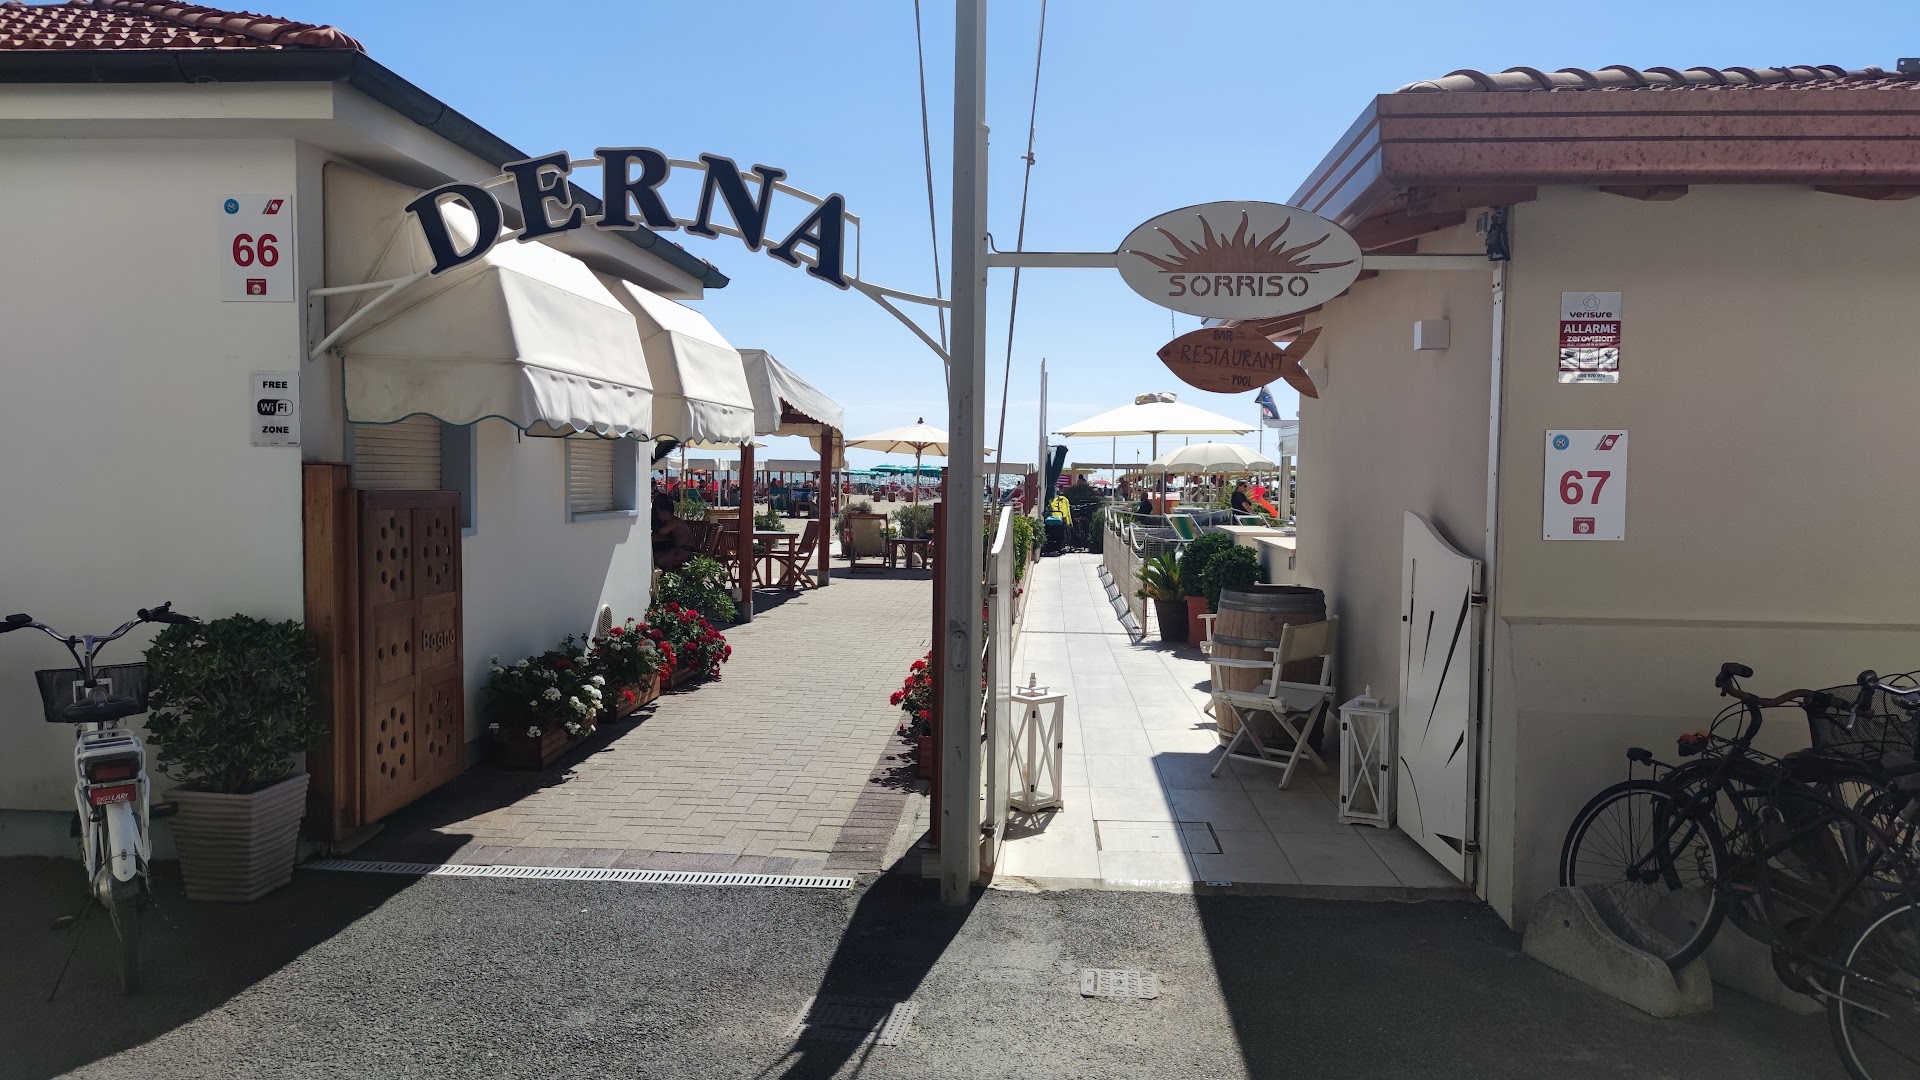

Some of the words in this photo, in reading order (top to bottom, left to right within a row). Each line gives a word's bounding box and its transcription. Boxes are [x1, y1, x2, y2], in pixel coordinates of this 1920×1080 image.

[405, 146, 850, 290] DERNA
[232, 233, 279, 267] 66
[1168, 275, 1309, 297] SORRISO
[1212, 329, 1234, 341] BAR
[1563, 323, 1617, 334] ALLARME
[1180, 344, 1288, 371] RESTAURANT
[262, 381, 288, 389] FREE
[1232, 374, 1253, 387] POOL
[262, 425, 290, 434] ZONE
[1559, 470, 1611, 505] 67
[422, 629, 456, 653] Bagno
[111, 792, 129, 801] LARI
